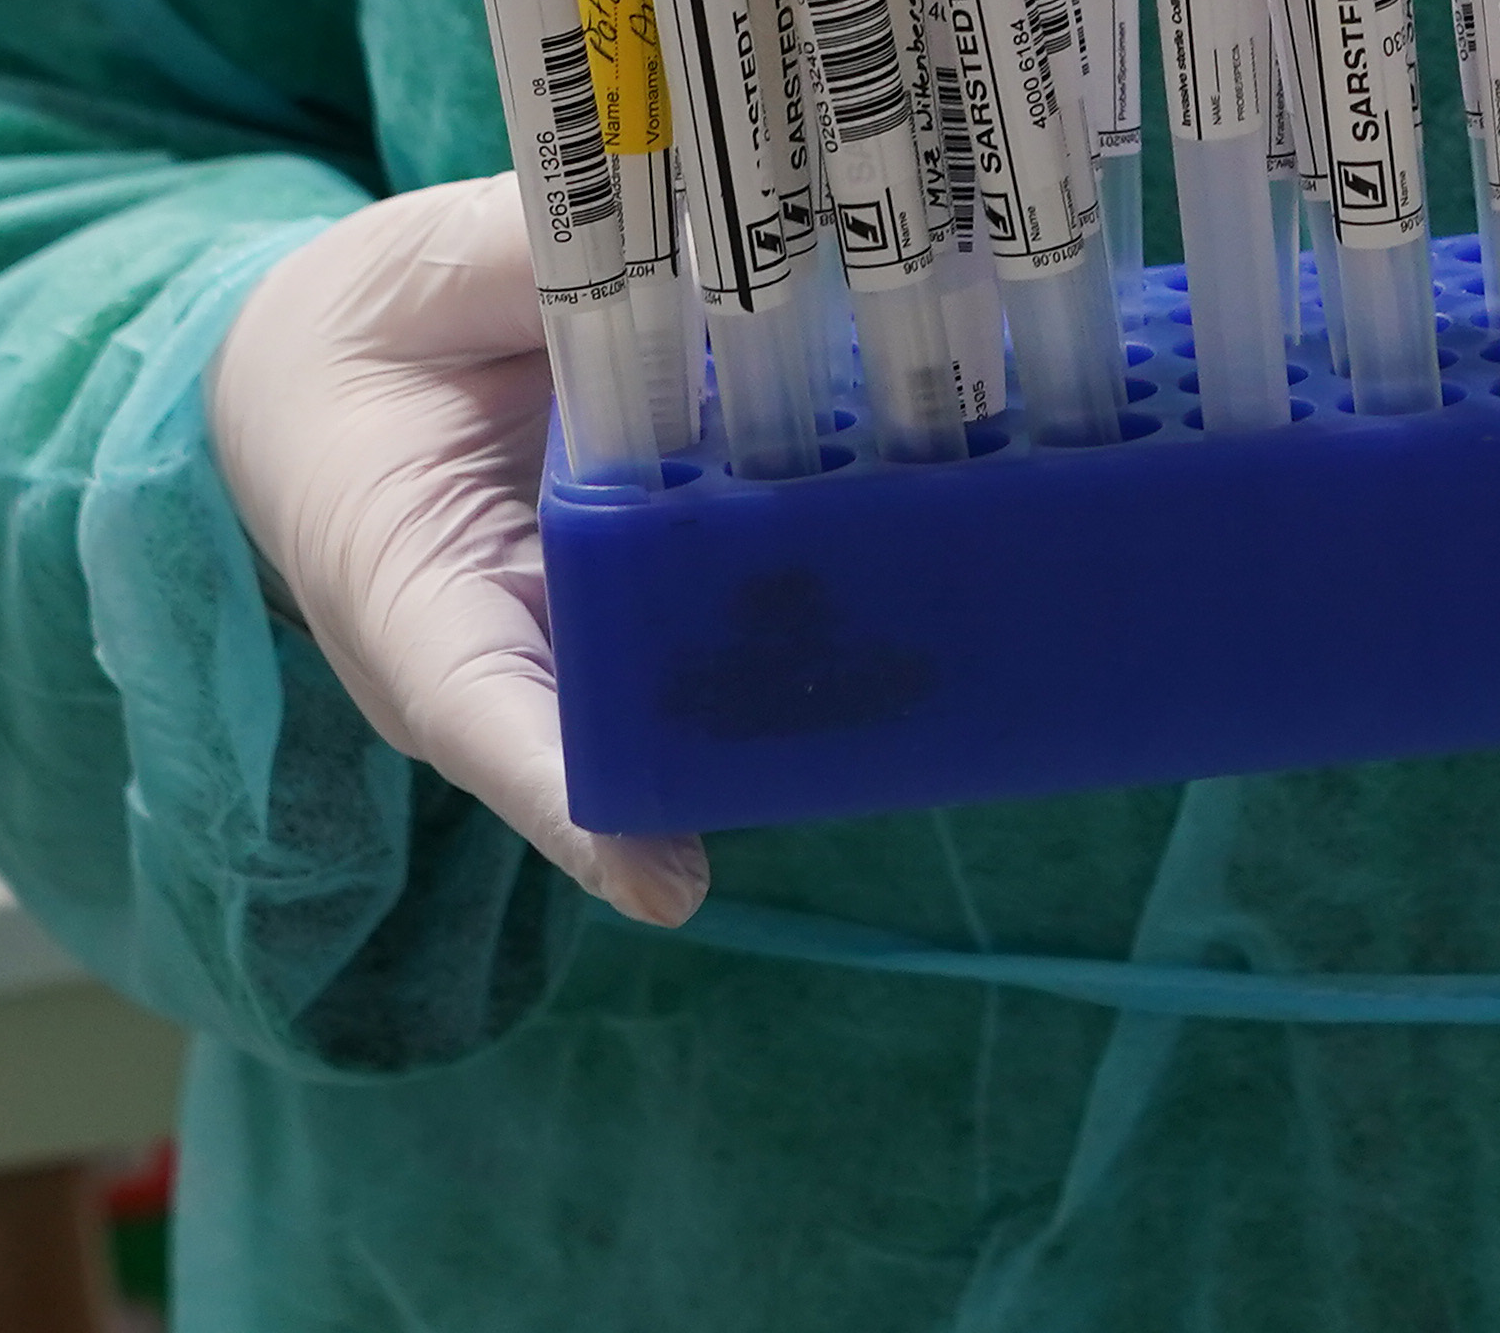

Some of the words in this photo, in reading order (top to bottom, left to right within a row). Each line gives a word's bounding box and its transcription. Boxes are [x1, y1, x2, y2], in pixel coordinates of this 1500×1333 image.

[803, 41, 825, 95] 3240
[1010, 18, 1036, 73] 6184
[532, 77, 547, 97] 08
[1023, 76, 1047, 130] 4000
[1177, 73, 1192, 127] Invasive
[605, 85, 620, 146] Name:
[816, 100, 839, 154] 0263
[536, 131, 561, 183] 1326
[545, 190, 573, 244] 0263
